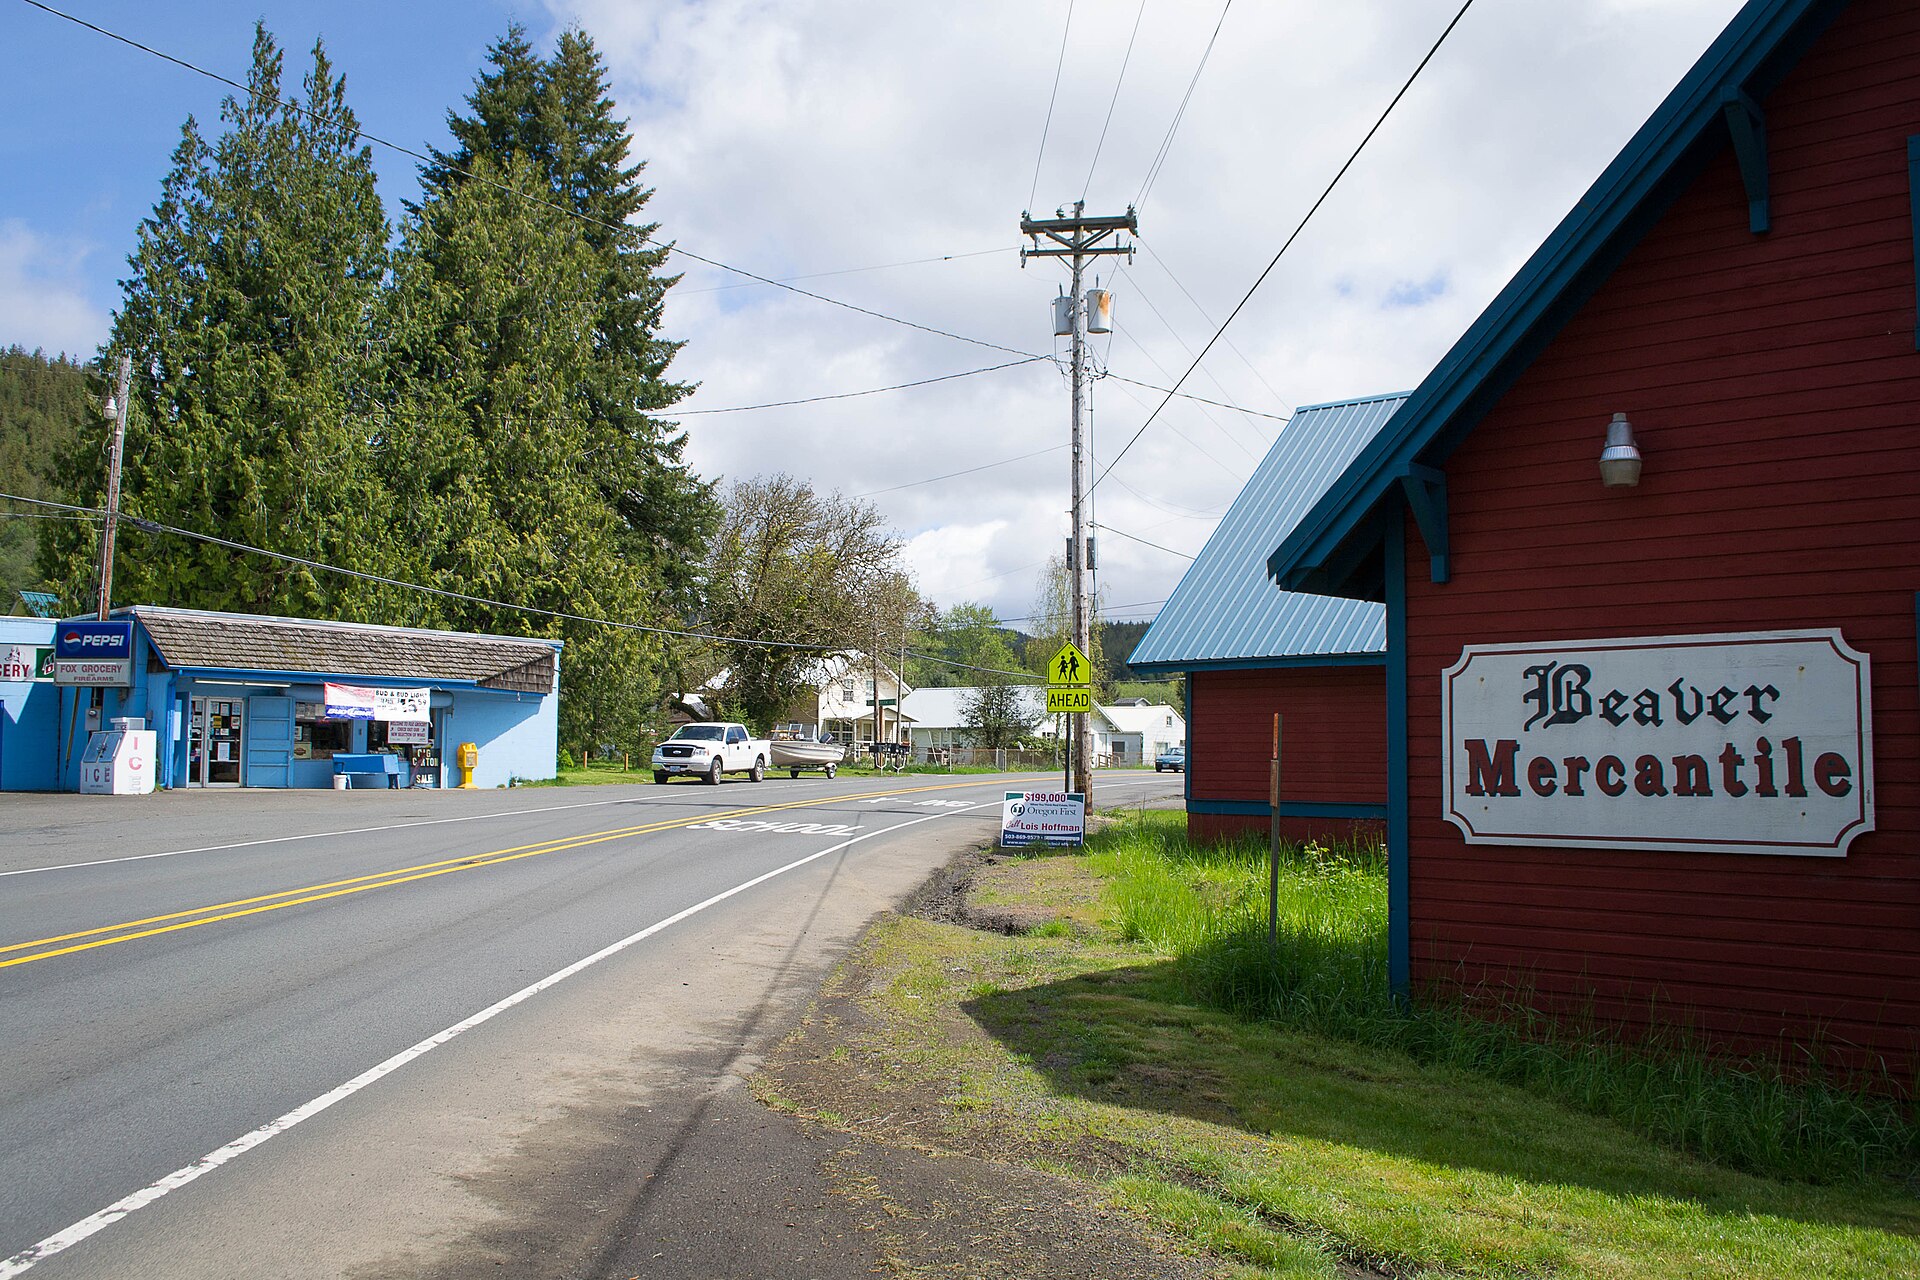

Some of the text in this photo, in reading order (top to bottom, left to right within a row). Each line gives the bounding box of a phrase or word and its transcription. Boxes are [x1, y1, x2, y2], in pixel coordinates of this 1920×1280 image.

[82, 635, 124, 646] PEPSI
[1049, 694, 1089, 707] AHEAD
[1522, 660, 1780, 732] Beaver
[412, 757, 439, 766] CRTON
[1464, 736, 1852, 798] Mercantile
[85, 767, 110, 782] ICE
[416, 774, 433, 783] SALE
[1024, 793, 1066, 802] $199,000
[1027, 807, 1057, 816] Oregon
[686, 819, 865, 836] SCHOOL
[1042, 823, 1080, 831] Hoffman
